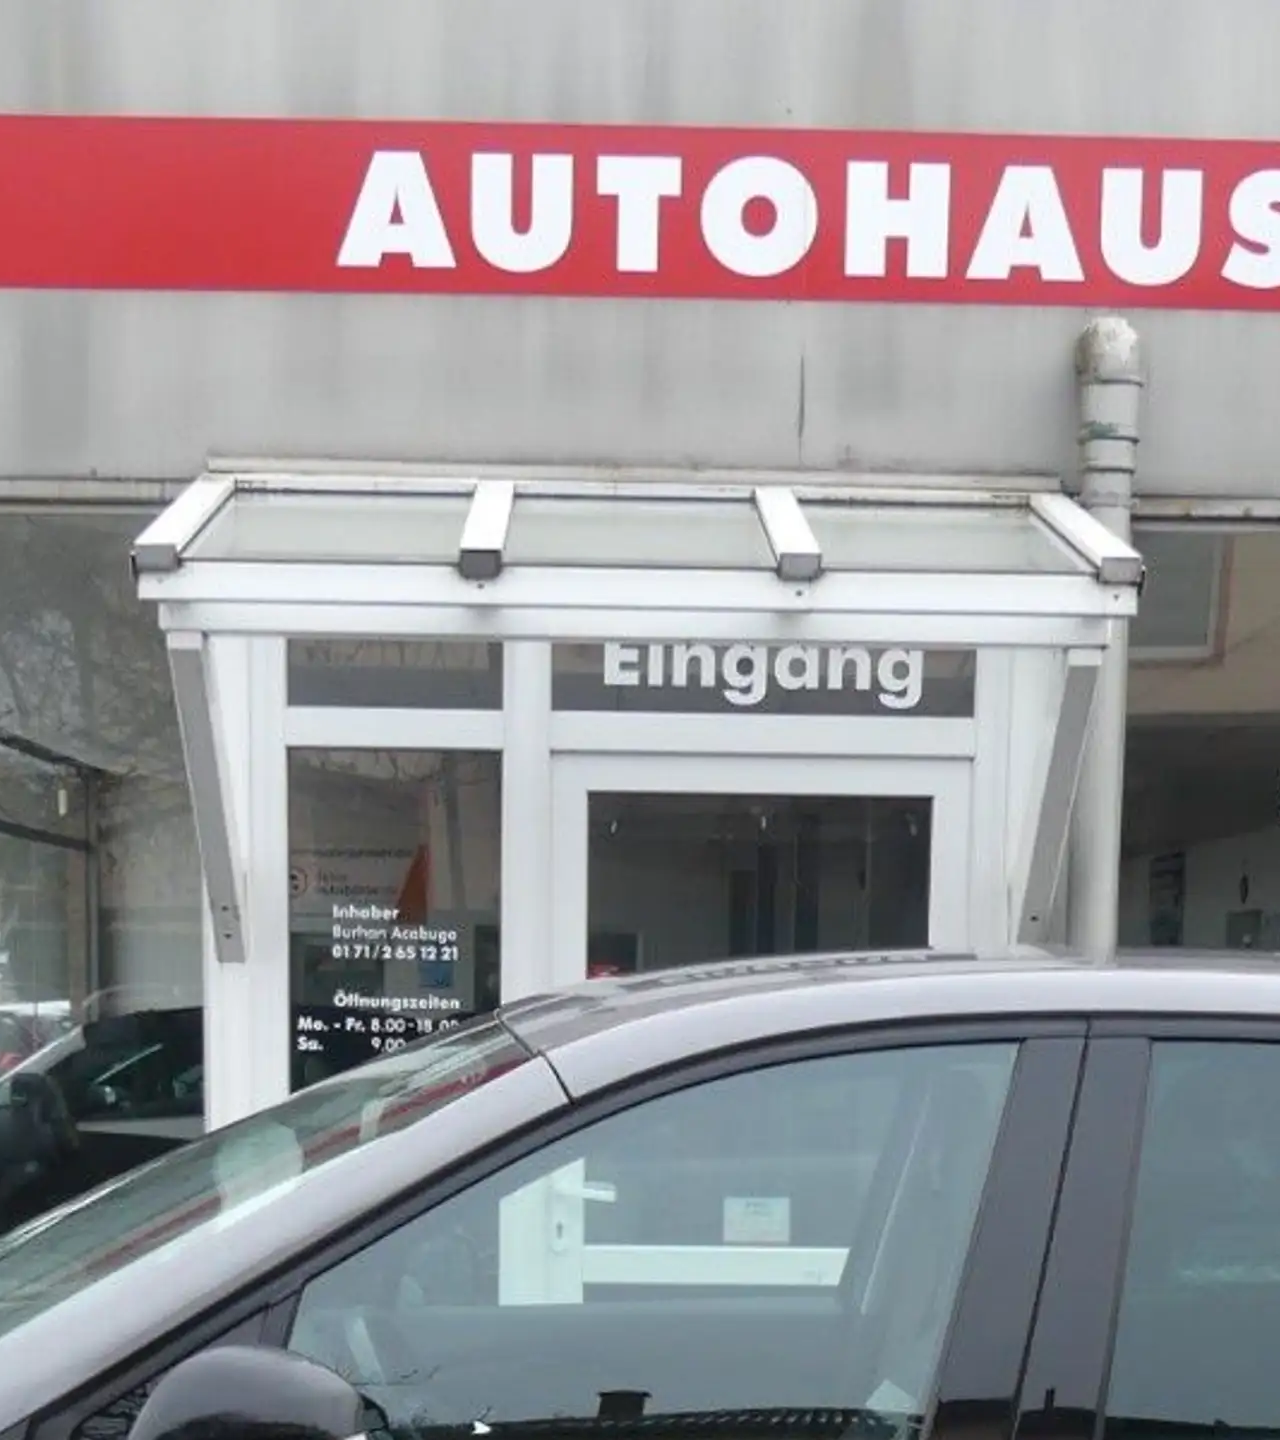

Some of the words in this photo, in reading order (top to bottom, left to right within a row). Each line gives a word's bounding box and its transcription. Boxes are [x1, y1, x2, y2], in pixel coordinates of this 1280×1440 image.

[602, 641, 924, 709] Eingang
[332, 904, 400, 920] Inhaber
[332, 924, 388, 940] Burhan
[333, 989, 460, 1011] Öffnungszeiten
[297, 1015, 329, 1031] Mo.
[345, 1017, 366, 1032] Fr.
[297, 1036, 324, 1050] Sa.
